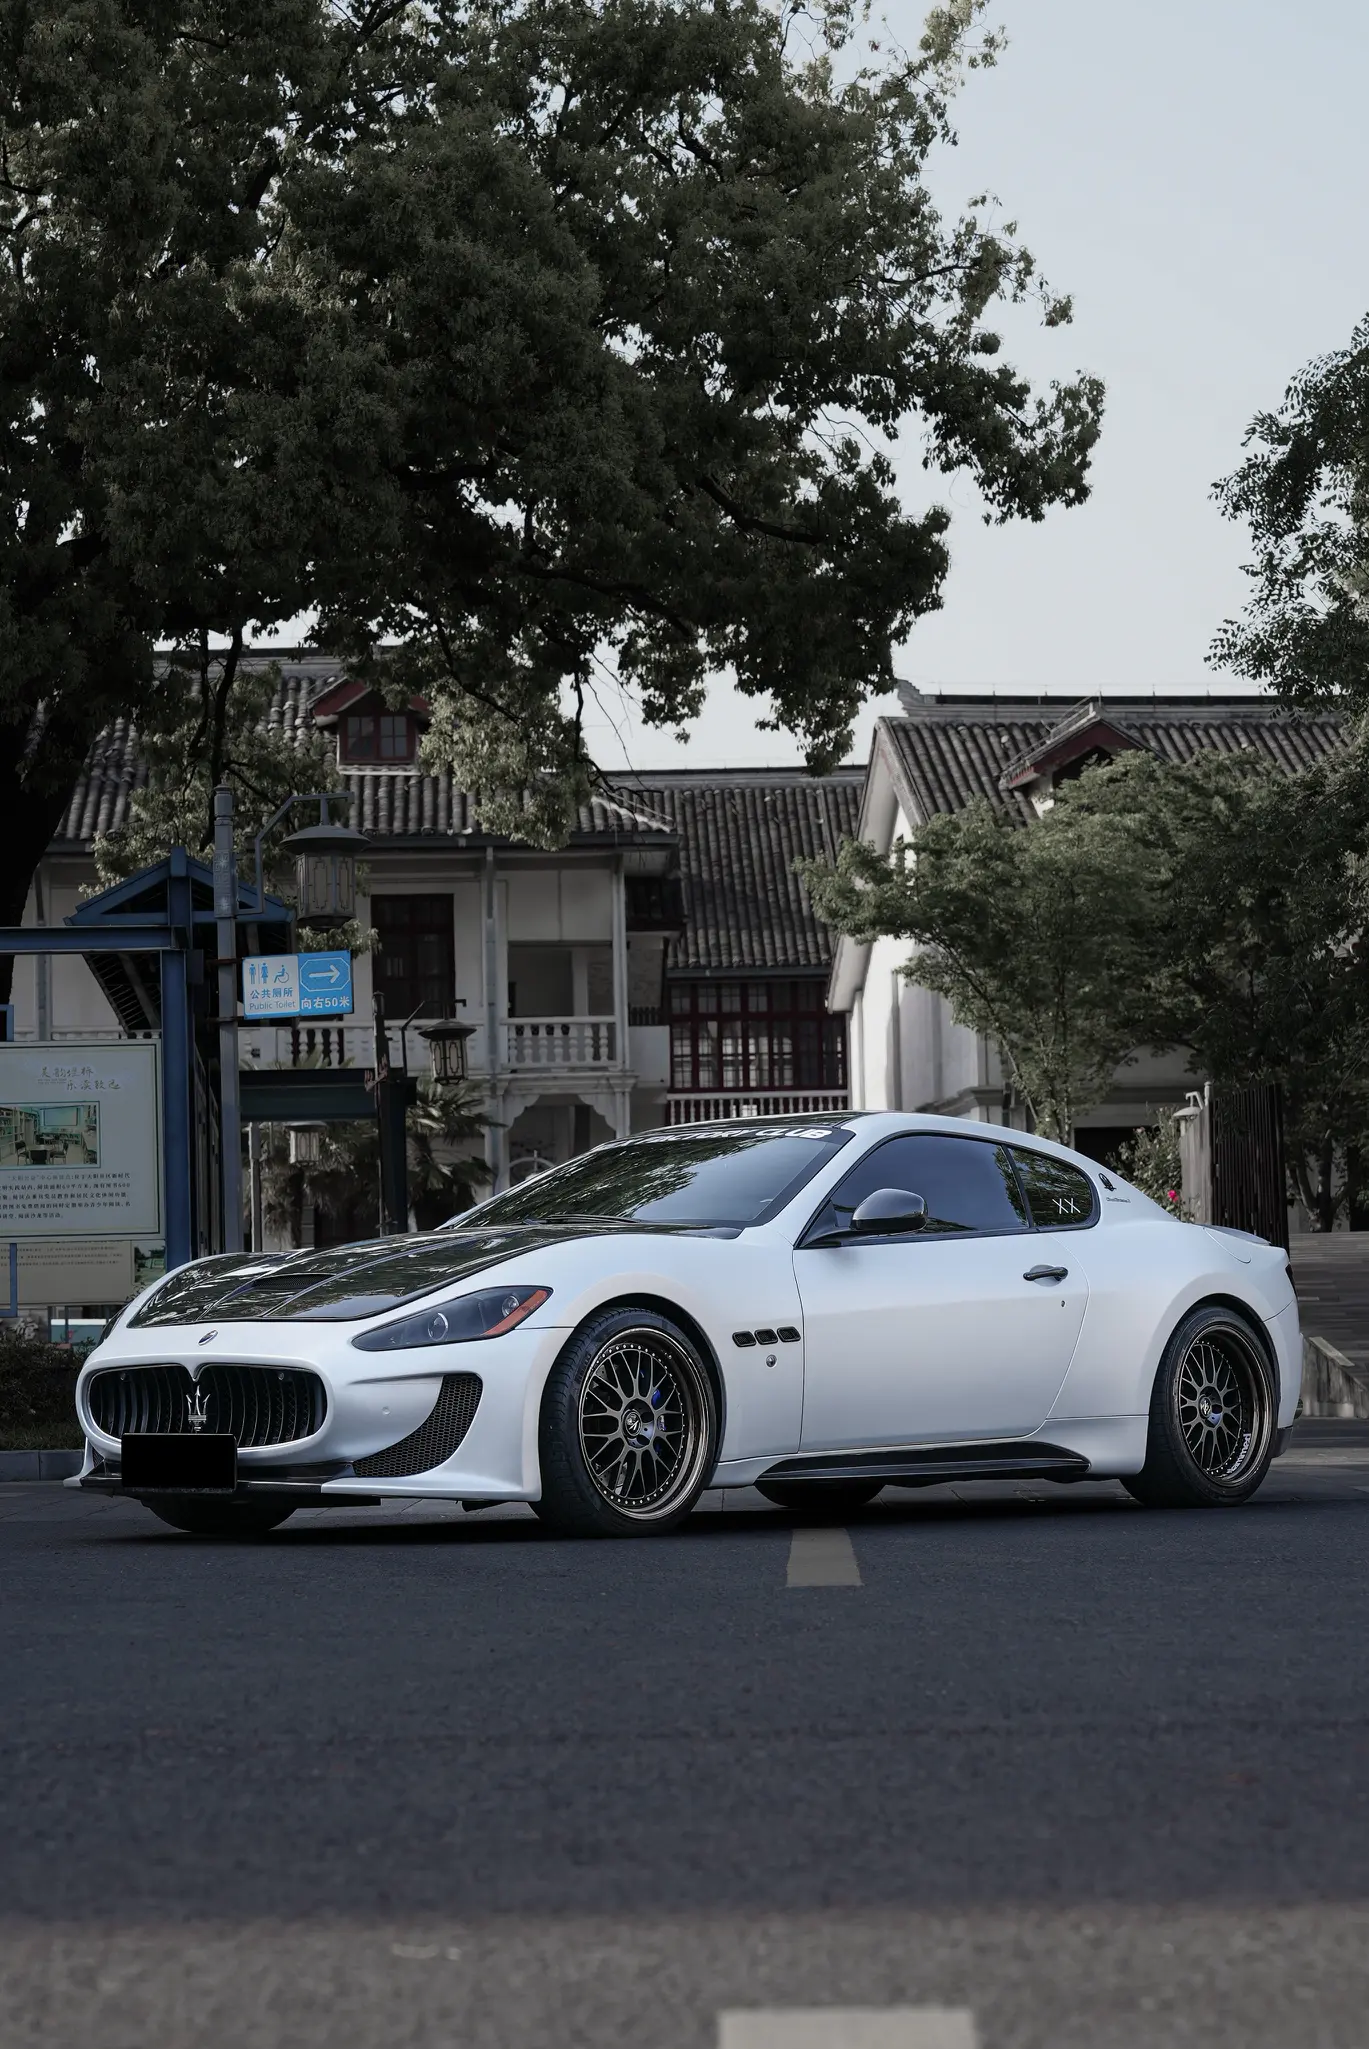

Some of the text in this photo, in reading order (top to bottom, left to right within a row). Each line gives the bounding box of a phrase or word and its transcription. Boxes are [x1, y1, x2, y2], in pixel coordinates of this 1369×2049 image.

[250, 987, 294, 1000] 公共厕所
[249, 1000, 296, 1011] Public Toilet
[301, 996, 350, 1010] 向右50米
[756, 1128, 832, 1139] CLUB
[1052, 1197, 1081, 1215] XX
